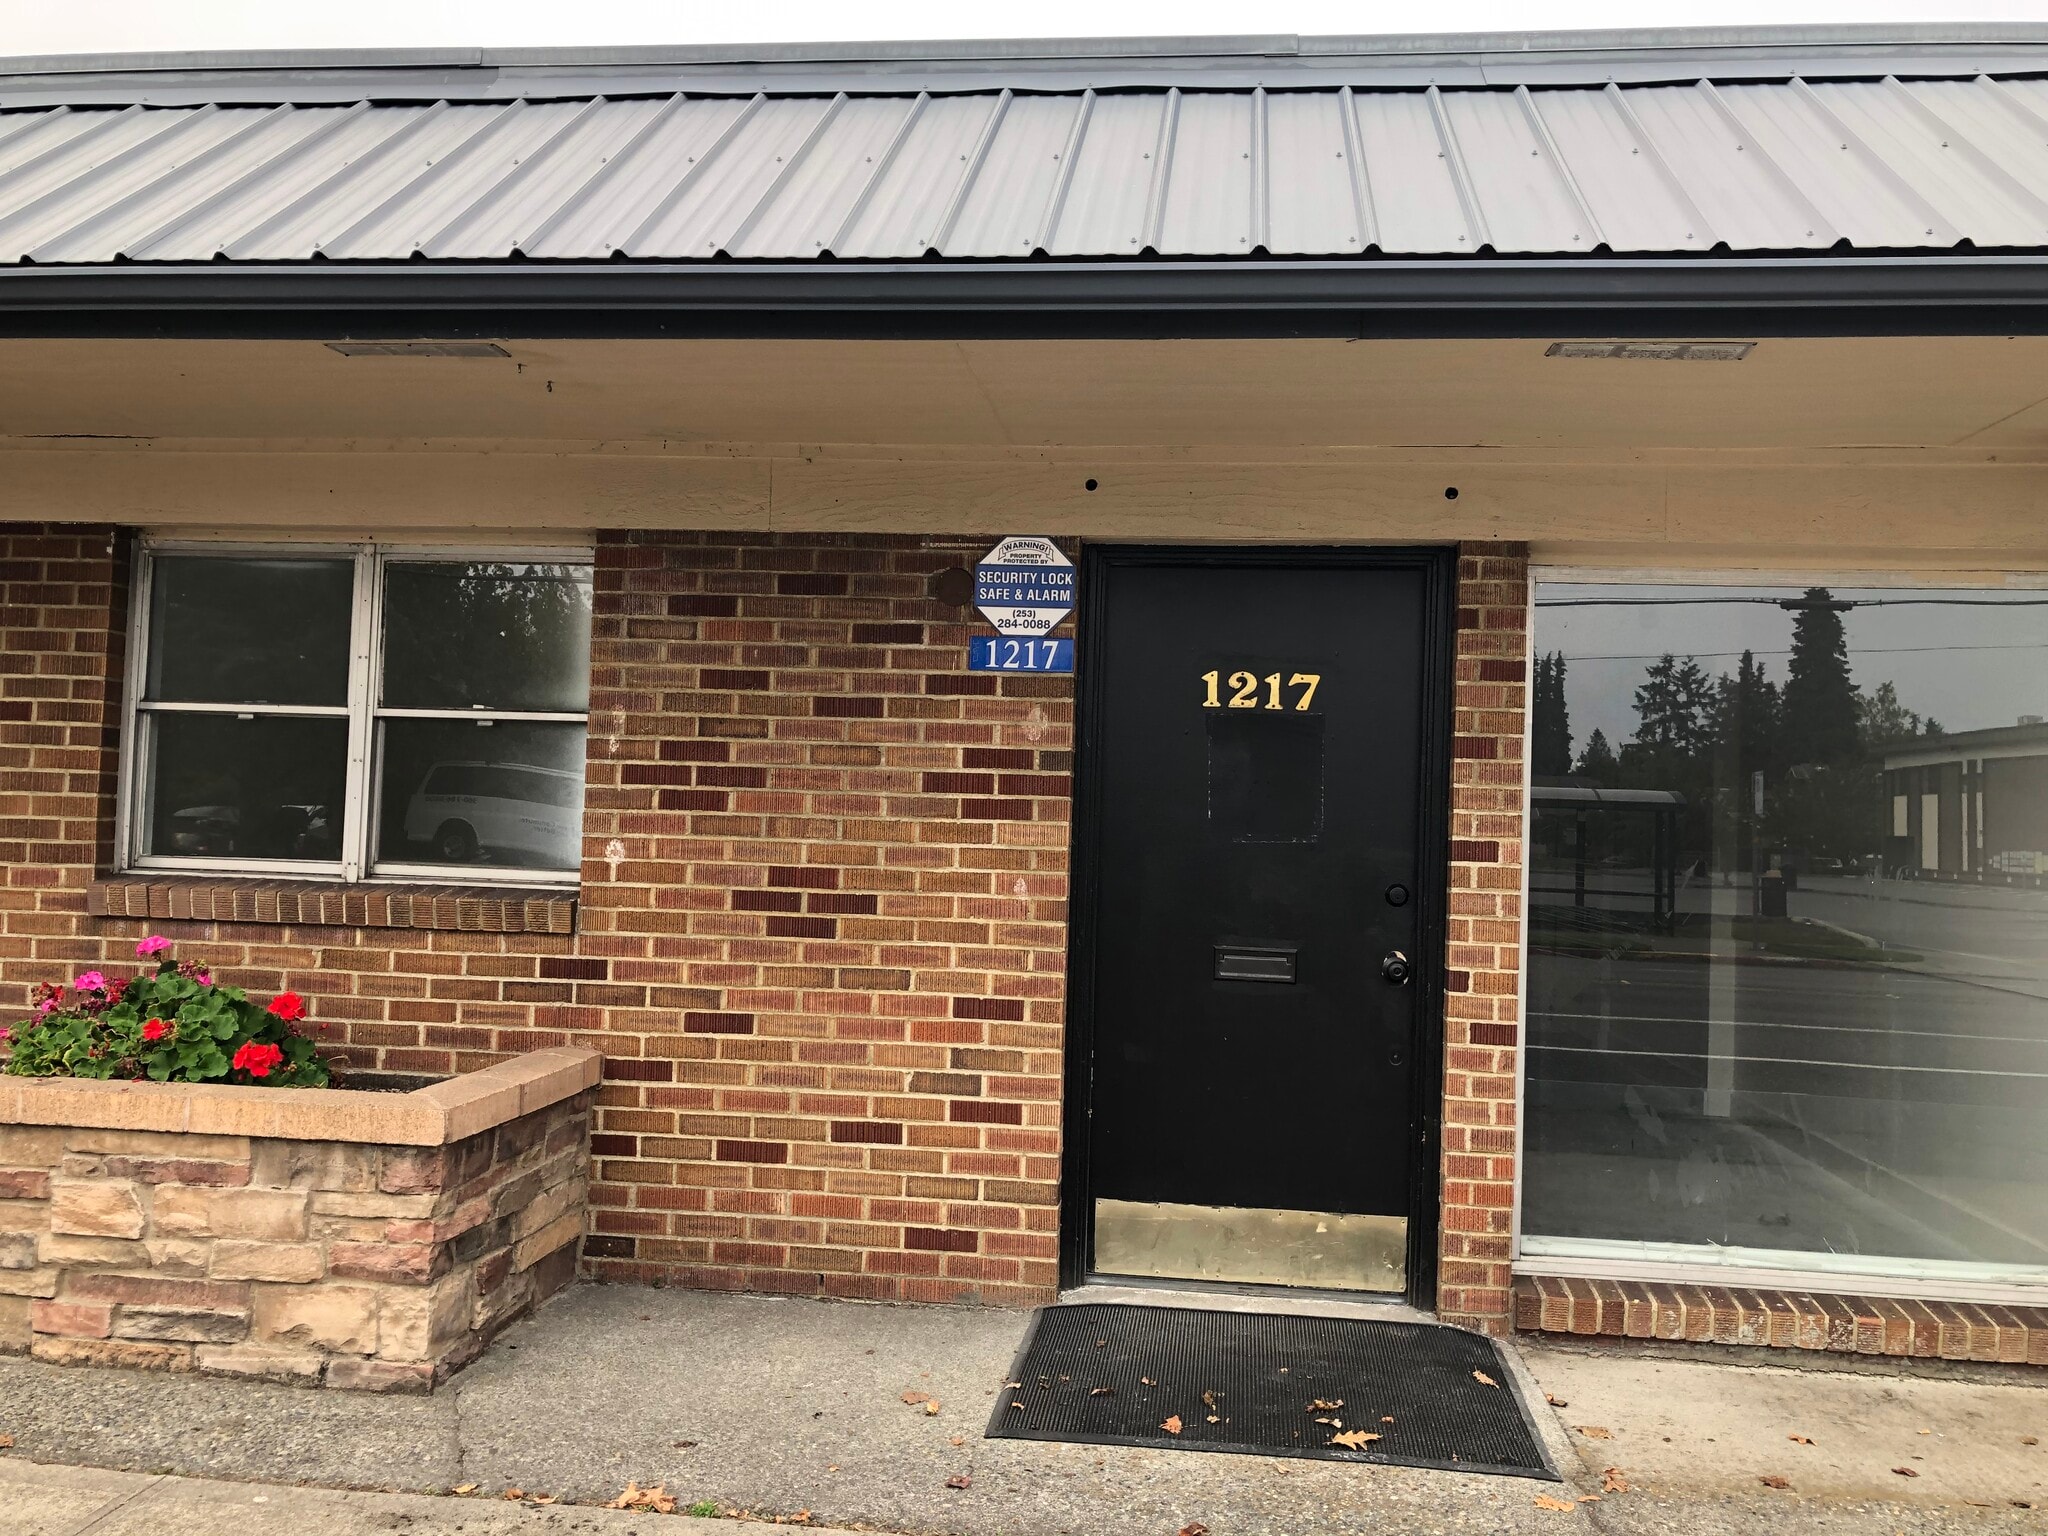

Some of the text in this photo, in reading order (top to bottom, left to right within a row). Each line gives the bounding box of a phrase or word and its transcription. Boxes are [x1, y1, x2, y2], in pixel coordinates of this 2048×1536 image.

[1003, 541, 1049, 553] WARNING!
[979, 571, 1073, 585] SECURITY LOCK
[979, 587, 1071, 602] SAFE & ALARM
[1012, 609, 1036, 619] (253)
[997, 618, 1051, 629] 284-0088
[985, 639, 1060, 669] 1217
[1201, 670, 1321, 711] 1217
